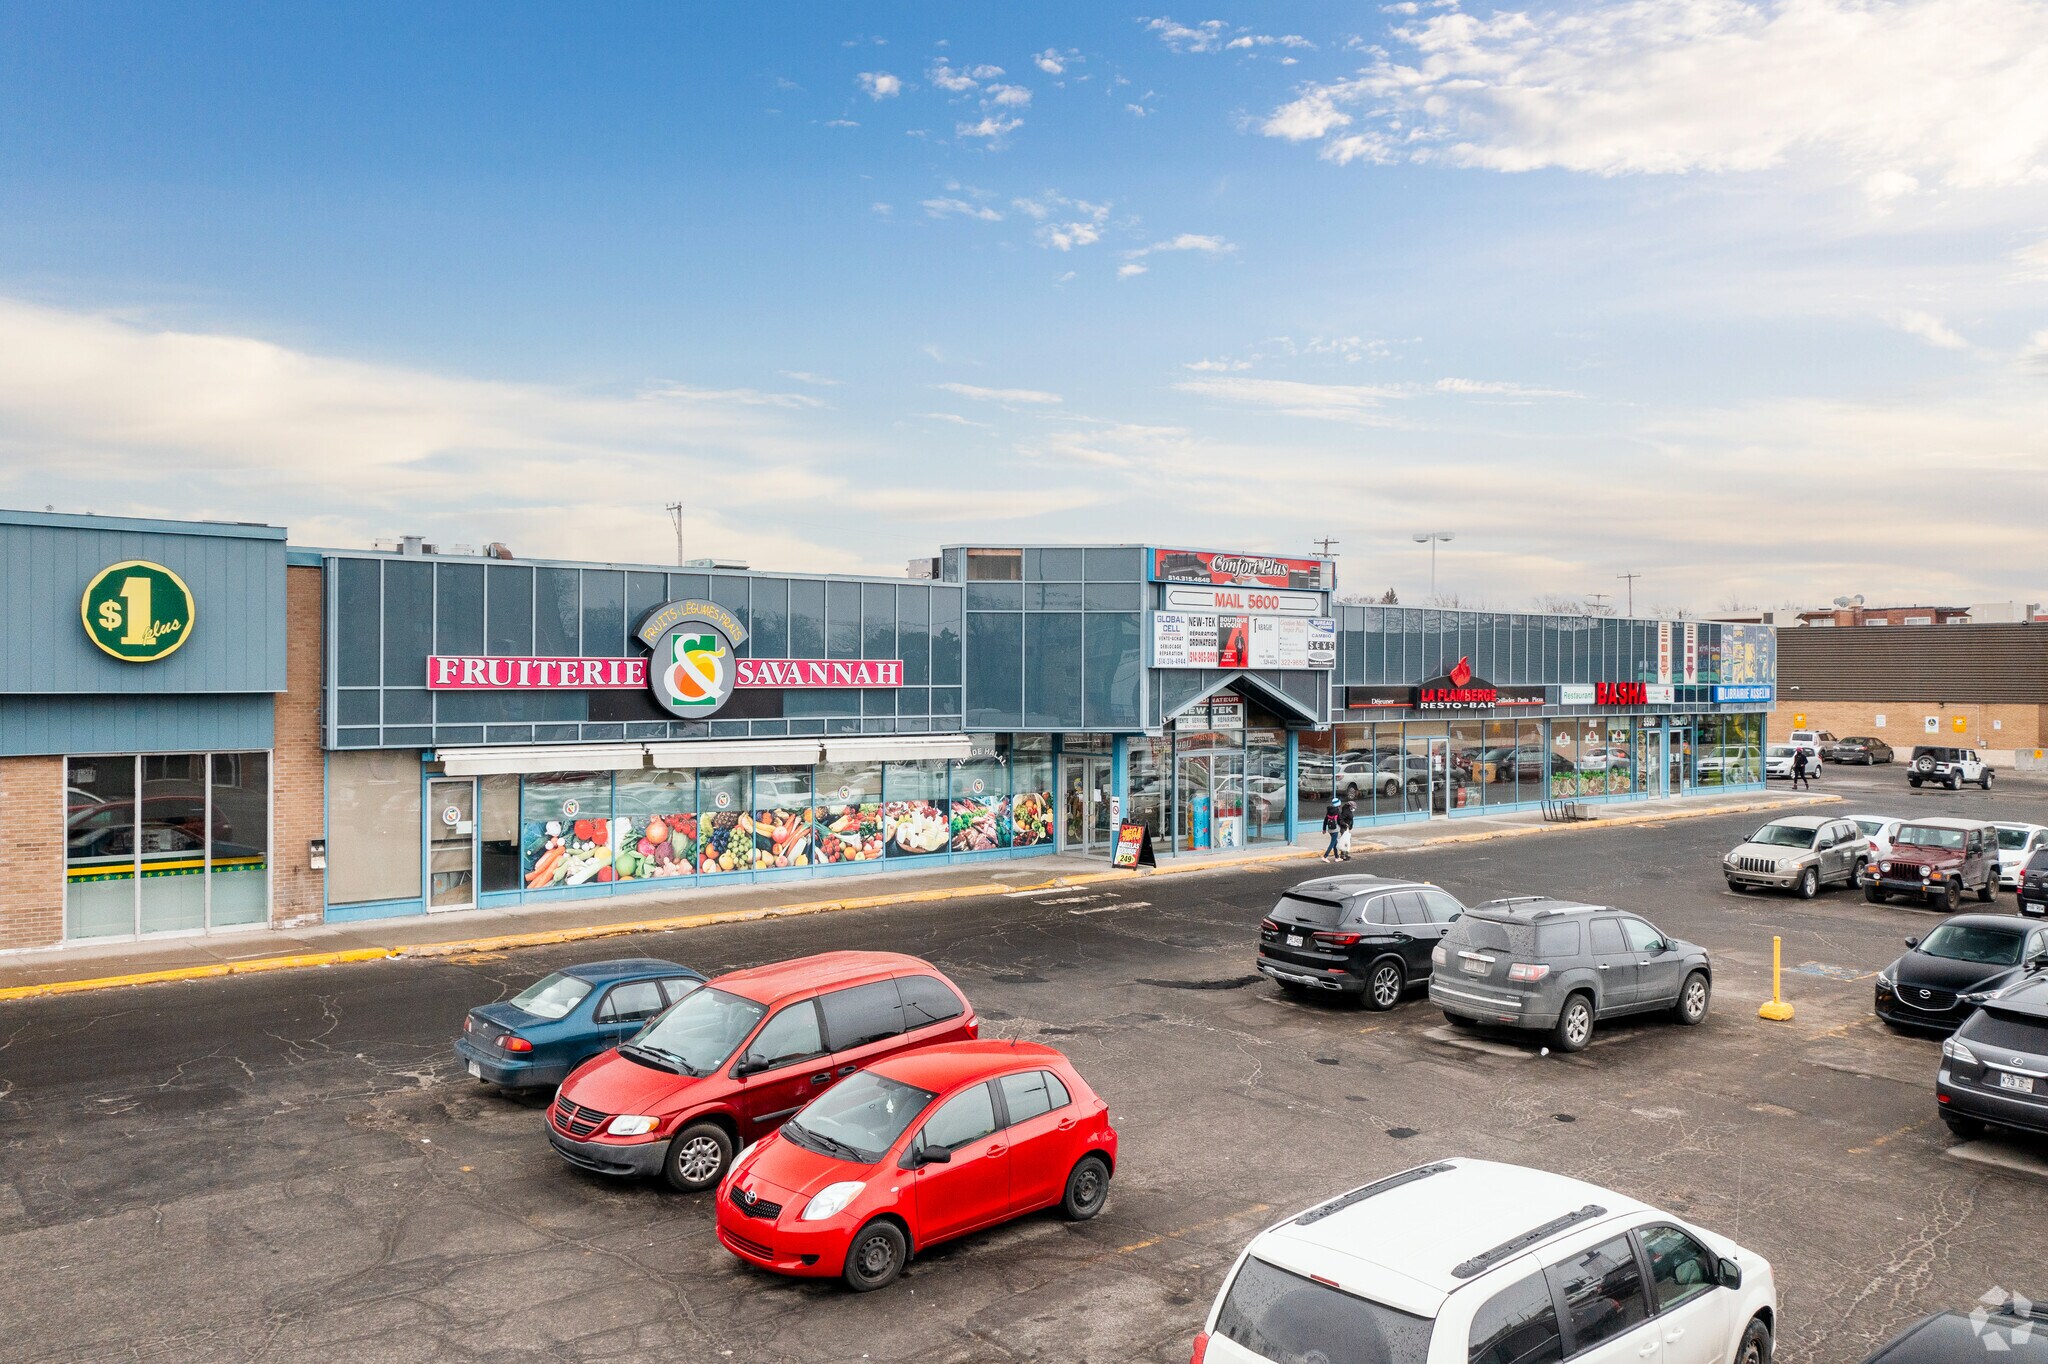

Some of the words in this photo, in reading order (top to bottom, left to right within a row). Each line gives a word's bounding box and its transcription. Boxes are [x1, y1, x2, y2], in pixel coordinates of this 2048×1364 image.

[1211, 555, 1259, 578] Confort
[1260, 558, 1288, 577] Plus
[1214, 593, 1244, 608] MAIL
[1248, 595, 1279, 610] 5600
[643, 608, 677, 641] FRUITS
[1157, 615, 1185, 623] GLOBAL
[1188, 616, 1216, 627] NEW-TEK
[142, 618, 182, 646] plus
[1163, 624, 1181, 632] CELL
[1189, 638, 1217, 647] ORDINATEUR
[434, 657, 646, 687] FRUITERIE
[736, 660, 899, 686] SAVANNAH
[1421, 688, 1435, 702] LA
[1563, 691, 1594, 700] Restaurant
[1597, 682, 1648, 705] BASHA
[1750, 687, 1771, 699] ASSELIN
[984, 747, 1007, 767] HALAL
